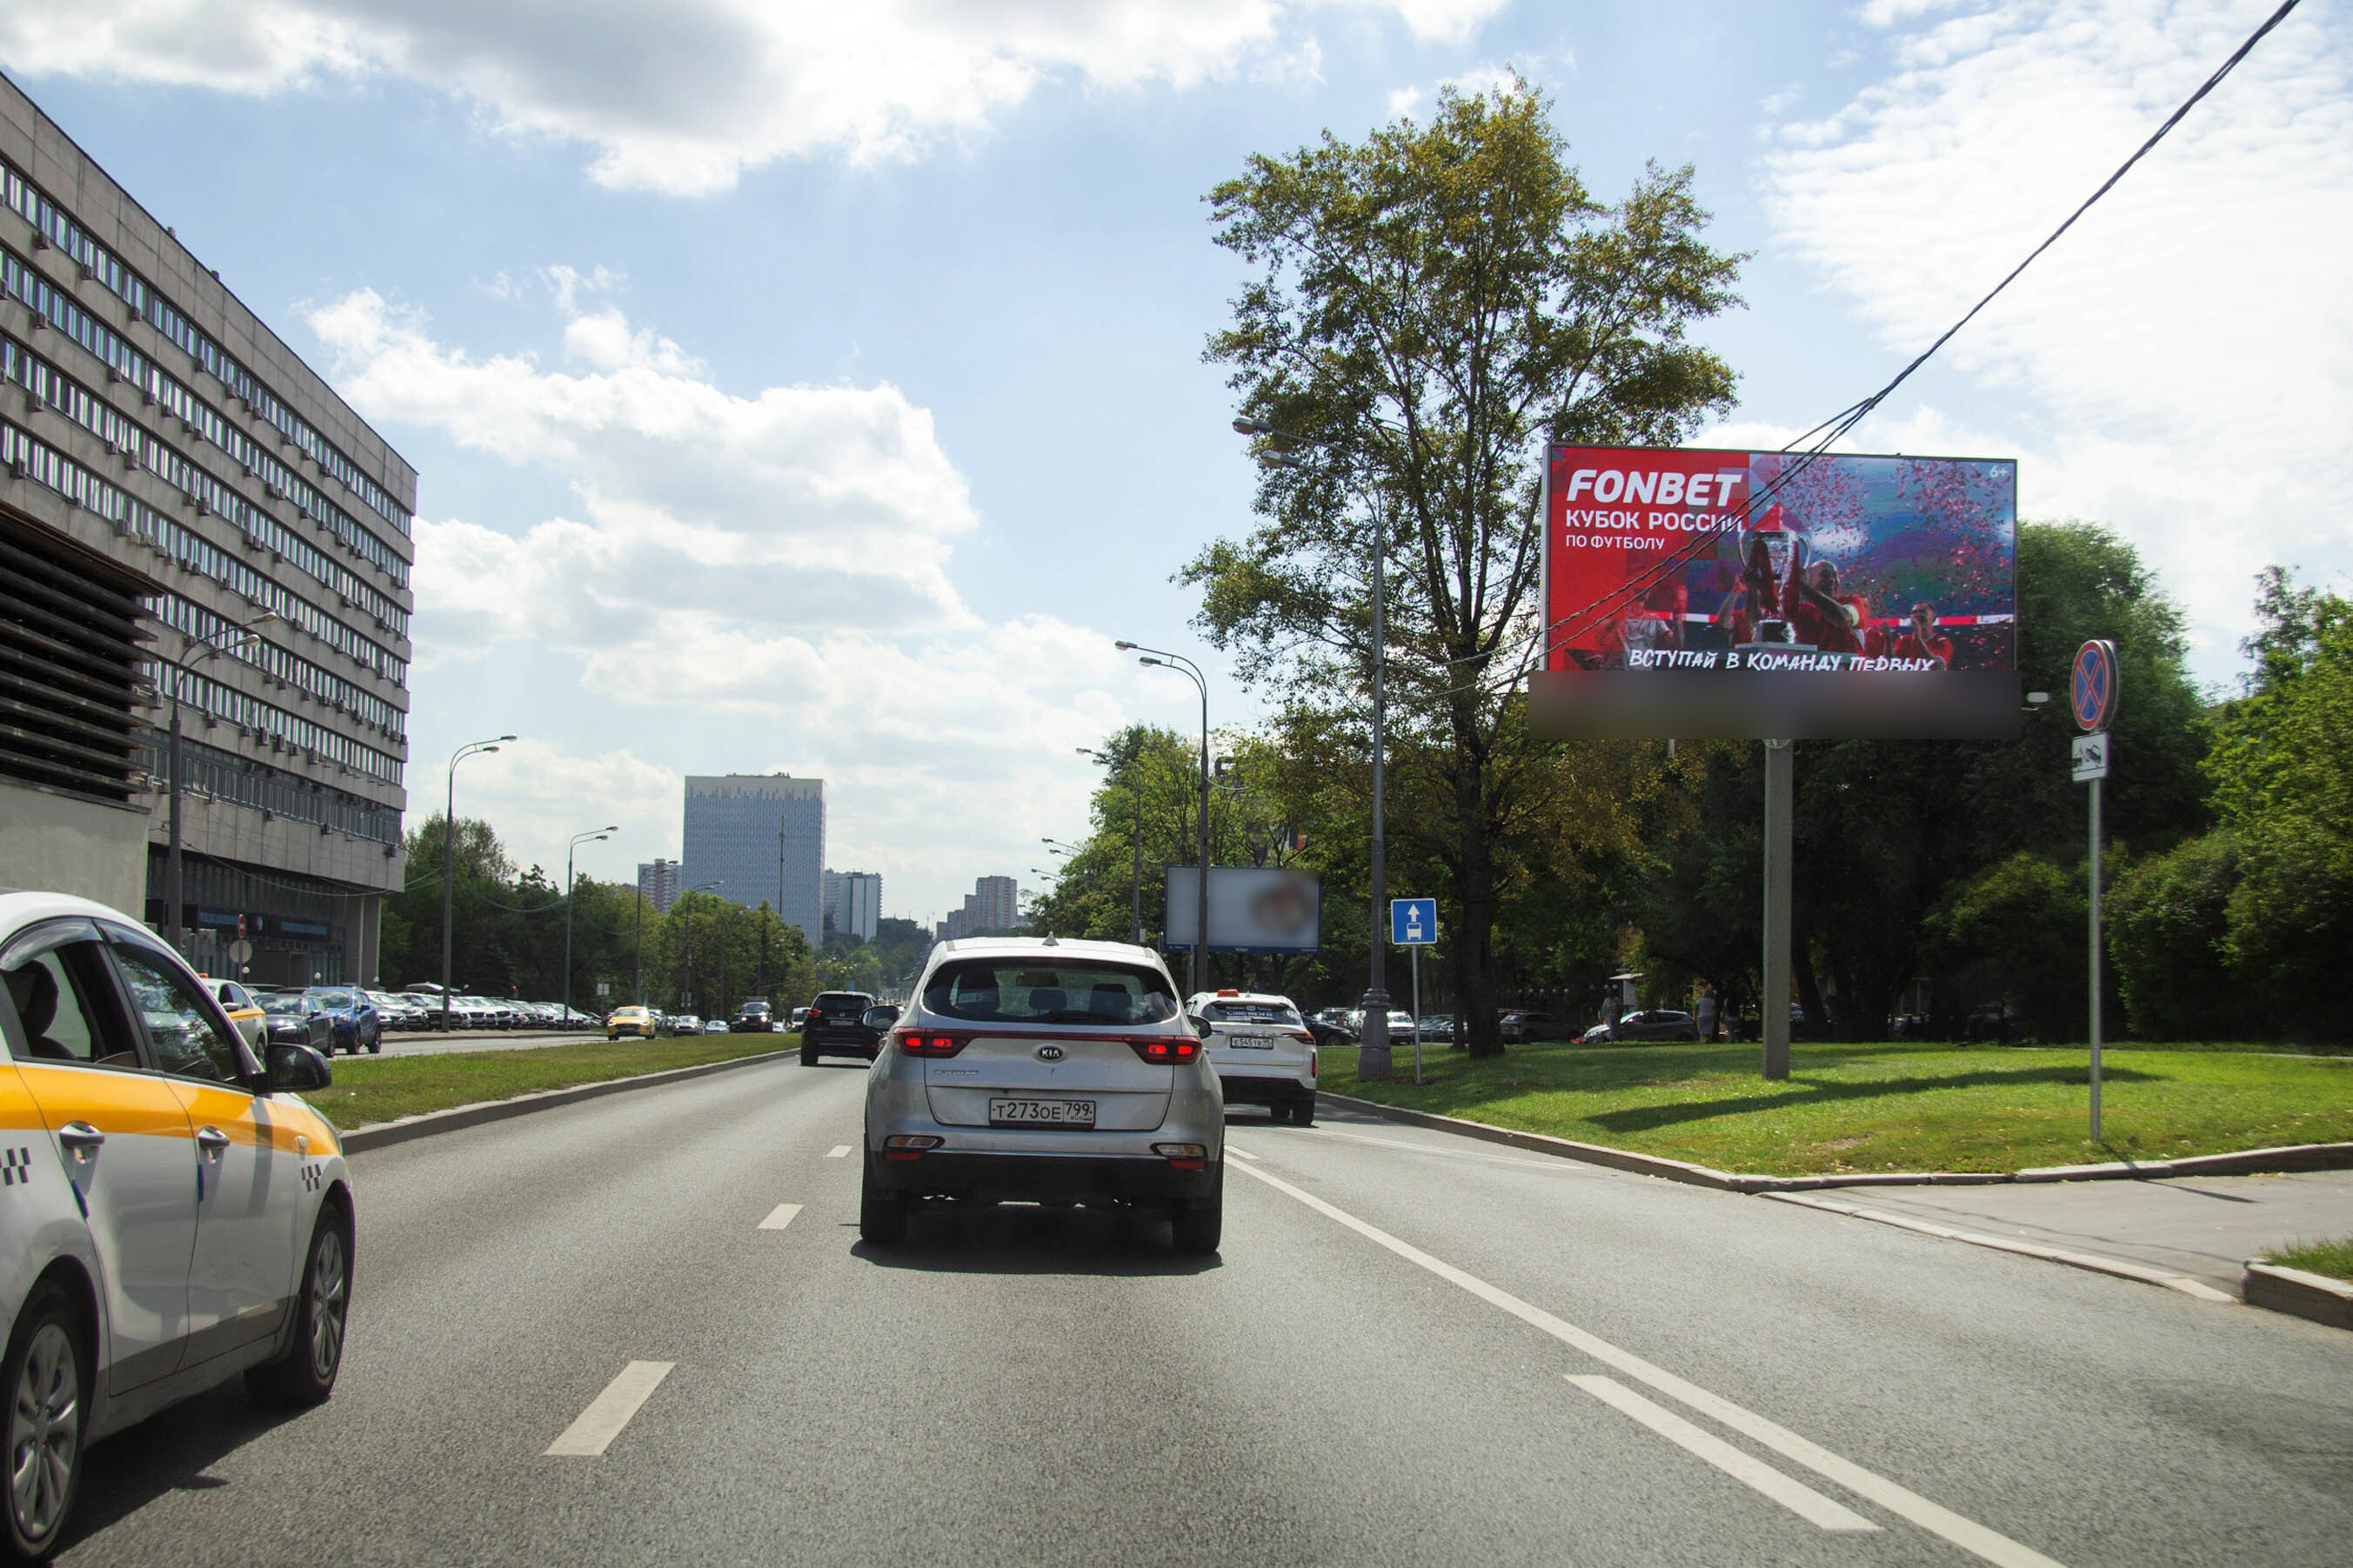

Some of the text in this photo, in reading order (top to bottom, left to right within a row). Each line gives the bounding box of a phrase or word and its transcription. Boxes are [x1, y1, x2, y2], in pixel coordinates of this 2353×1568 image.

[1566, 469, 1743, 507] FONBET
[1566, 509, 1743, 533] КУБОК РОССИИ
[1566, 534, 1665, 550] ПО ФУТБОЛУ
[1628, 649, 1718, 669] ВСТУПАЙ
[1725, 652, 1740, 669] В
[1747, 651, 1842, 671] КОМАНДУ
[1041, 1048, 1060, 1058] KIA
[1066, 1103, 1090, 1116] 799
